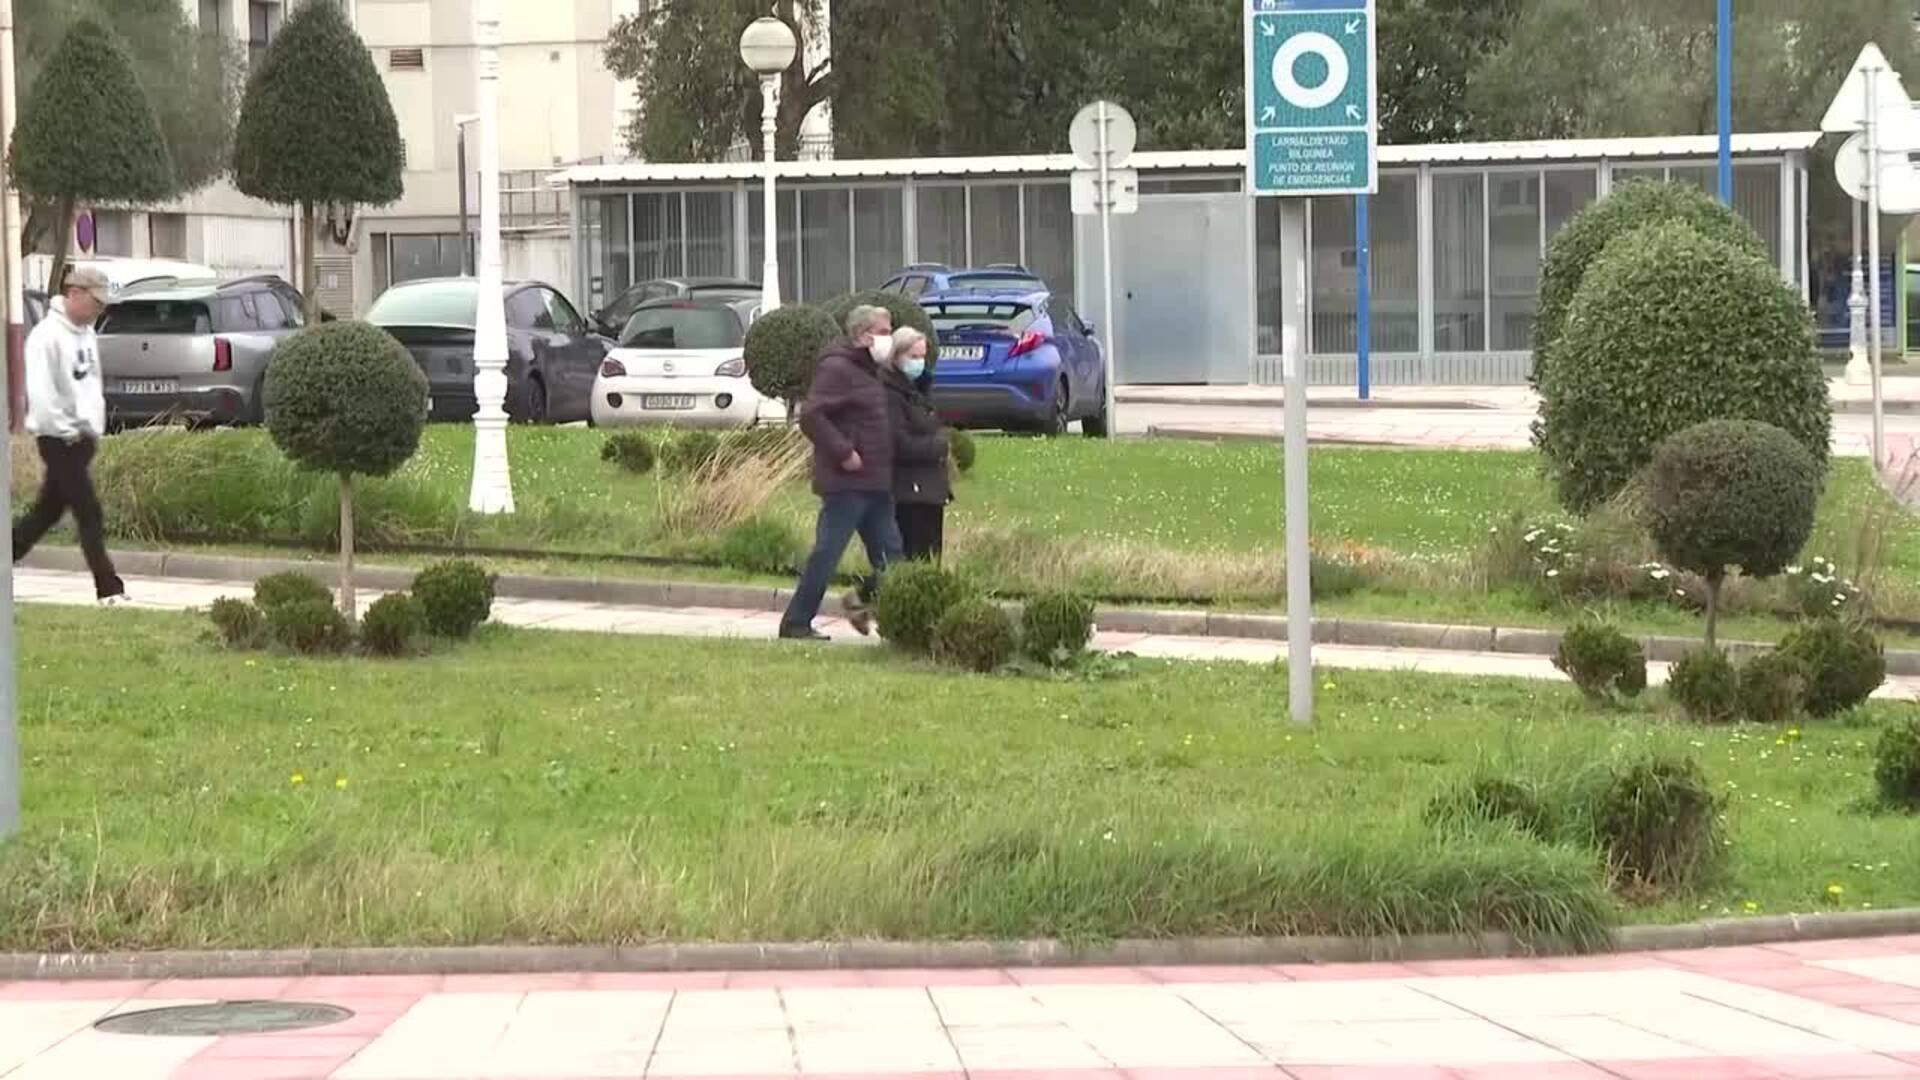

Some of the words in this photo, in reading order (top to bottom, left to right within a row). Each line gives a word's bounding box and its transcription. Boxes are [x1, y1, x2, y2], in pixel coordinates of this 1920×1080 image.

[1271, 136, 1348, 147] LARRIALDIETAKO
[1288, 148, 1334, 159] BILGUNEA
[1269, 163, 1299, 173] PUNTO
[1301, 163, 1313, 172] DE
[1273, 174, 1286, 185] DE
[1287, 173, 1351, 185] EMERGENCIAS
